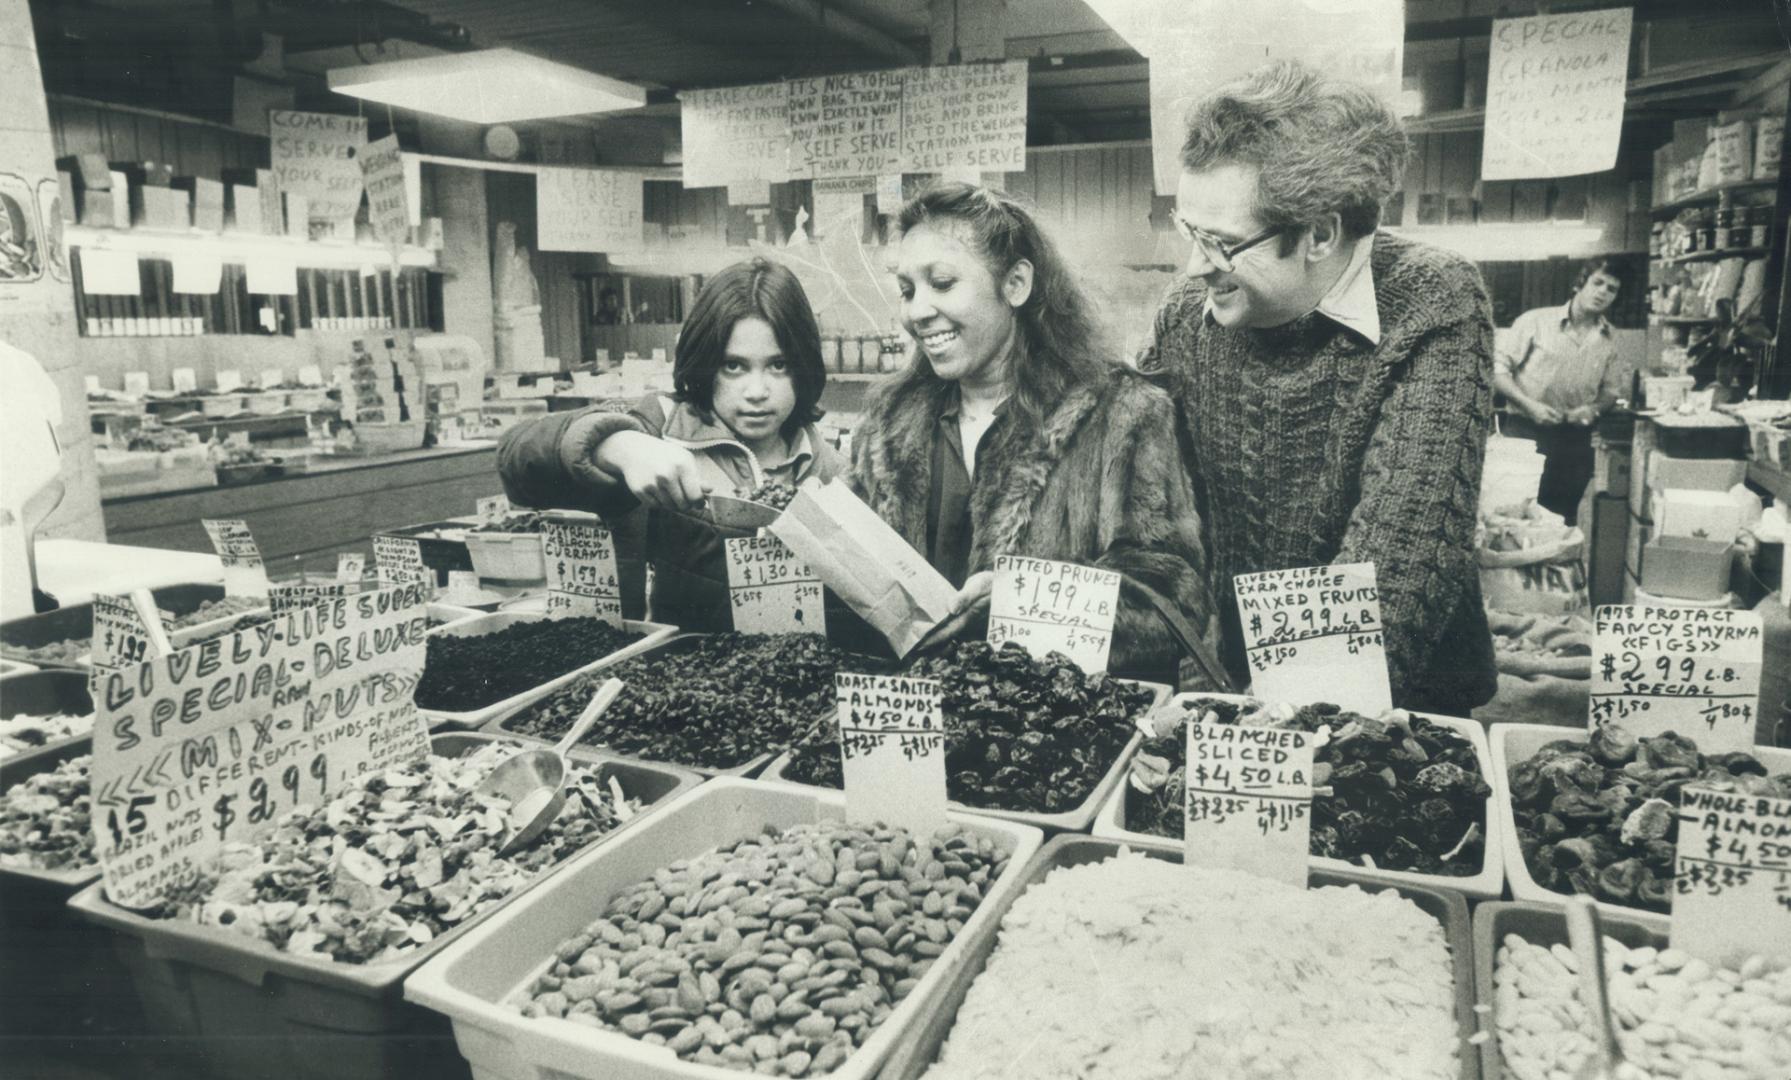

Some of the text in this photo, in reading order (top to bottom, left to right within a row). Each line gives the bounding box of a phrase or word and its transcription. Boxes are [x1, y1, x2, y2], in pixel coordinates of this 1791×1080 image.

[1498, 19, 1618, 52] SPECIAL
[823, 75, 854, 93] NICE
[942, 92, 972, 107] YOUR
[272, 111, 338, 131] COME
[941, 106, 971, 122] AND
[924, 124, 946, 137] TO
[277, 137, 348, 160] SERVE
[803, 132, 898, 161] SELF SERVE
[912, 145, 1024, 170] SELF SERVE
[545, 543, 610, 561] CURRANTS
[997, 556, 1120, 586] PITTED PRUNES
[1235, 566, 1328, 587] LIVELY LIFE
[1237, 574, 1346, 597] EXRA CHOICE
[357, 581, 429, 620] SUPER
[1242, 586, 1378, 611] MIXED FRUITS
[1018, 602, 1093, 629] SPECIAL
[1596, 604, 1635, 621] 1978
[1645, 607, 1735, 623] PROTACT
[1596, 621, 1760, 641] FANCY SMYRNA
[272, 681, 311, 709] RAW
[837, 674, 876, 690] ROAST
[890, 678, 941, 697] SALTED
[1623, 682, 1713, 697] SPECIAL
[1193, 723, 1306, 749] BLANCHED
[1198, 743, 1290, 765] SLICED
[107, 795, 157, 847] 15
[166, 807, 202, 833] NUTS
